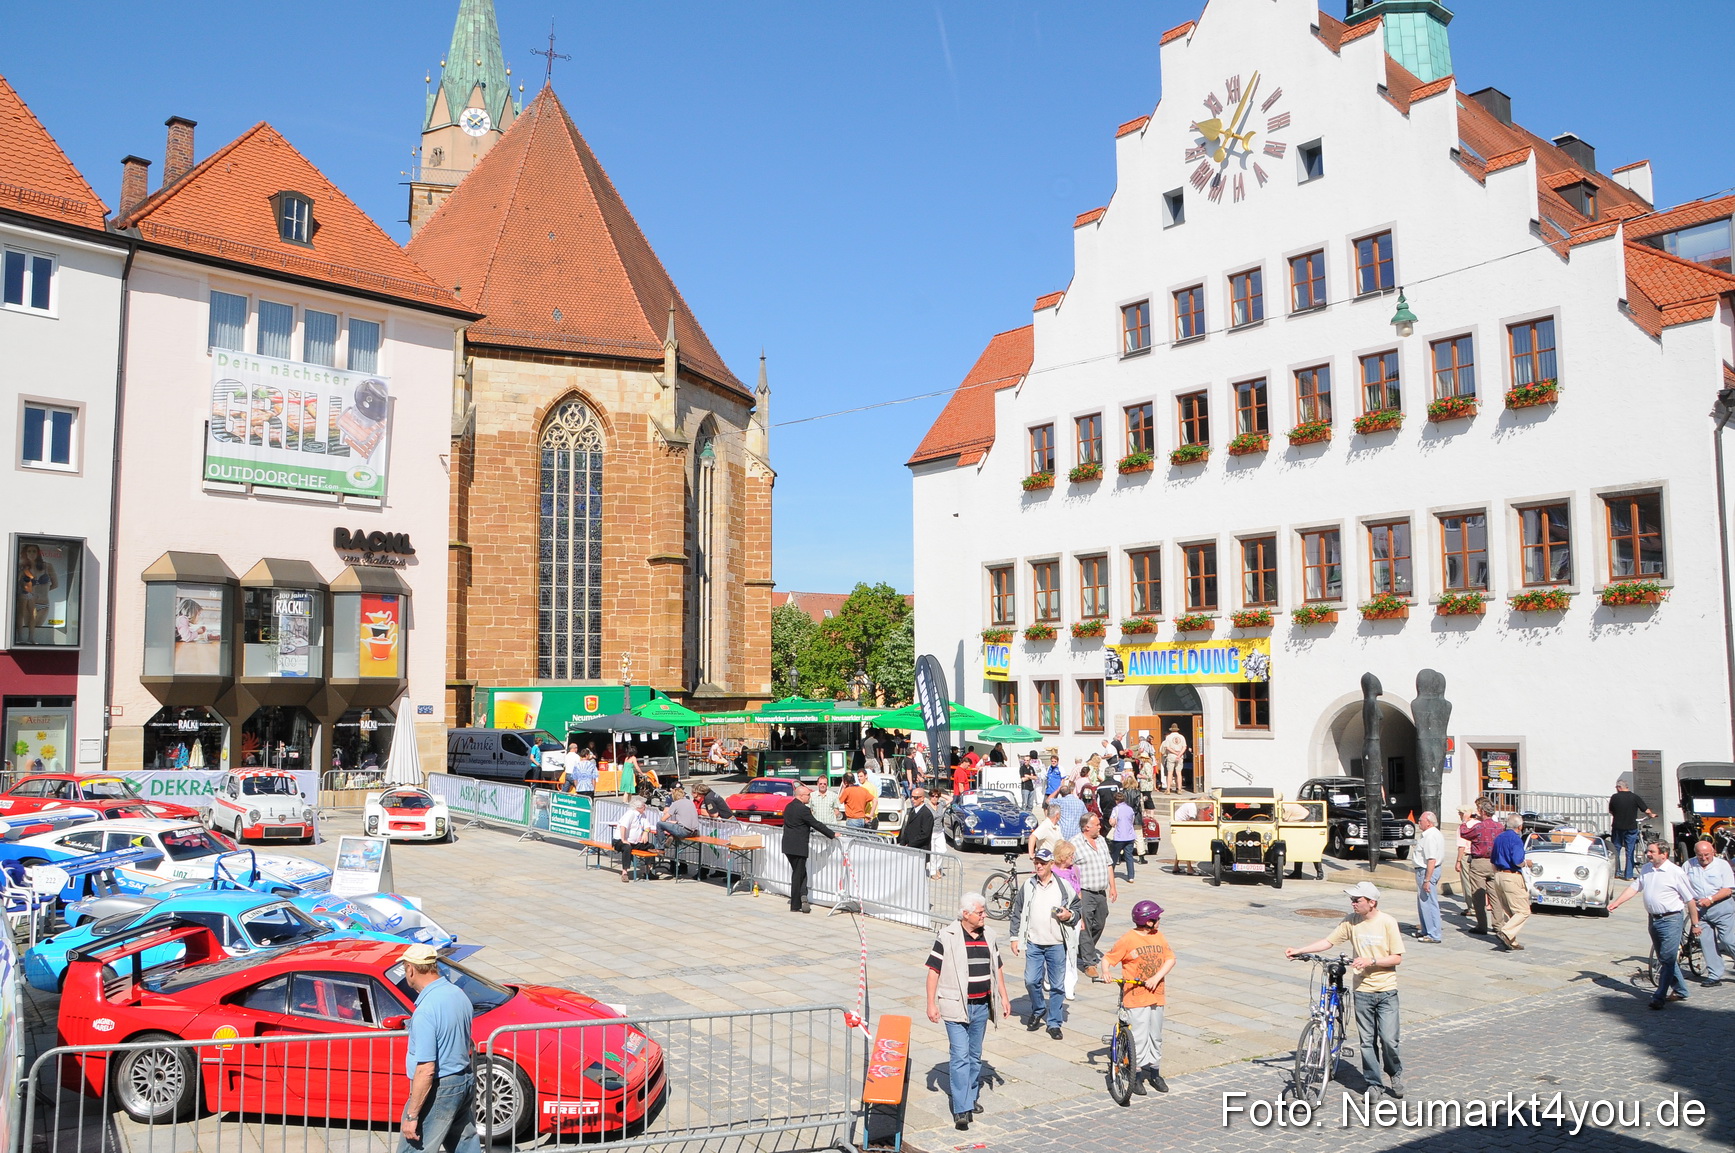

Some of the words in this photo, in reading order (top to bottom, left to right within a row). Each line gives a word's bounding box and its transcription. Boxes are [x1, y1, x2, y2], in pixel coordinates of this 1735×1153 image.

[217, 352, 260, 373] Dein
[270, 363, 351, 387] nächster
[211, 377, 351, 459] GRILL
[207, 462, 340, 491] OUTDOORCHEF.com
[333, 526, 416, 555] RACKL
[361, 551, 407, 567] Rathaus
[279, 592, 290, 600] 100
[275, 600, 304, 615] RACKL
[986, 646, 1009, 668] WC
[1128, 647, 1240, 676] ANMELDUNG
[178, 719, 199, 730] RACKL
[360, 720, 378, 729] RACKL
[754, 715, 785, 724] Neumarkter
[786, 714, 818, 724] Lammsbräu
[151, 779, 214, 796] DEKRA
[987, 780, 1023, 790] Informa
[366, 912, 403, 932] ACHS
[543, 1101, 600, 1115] PIRELLI
